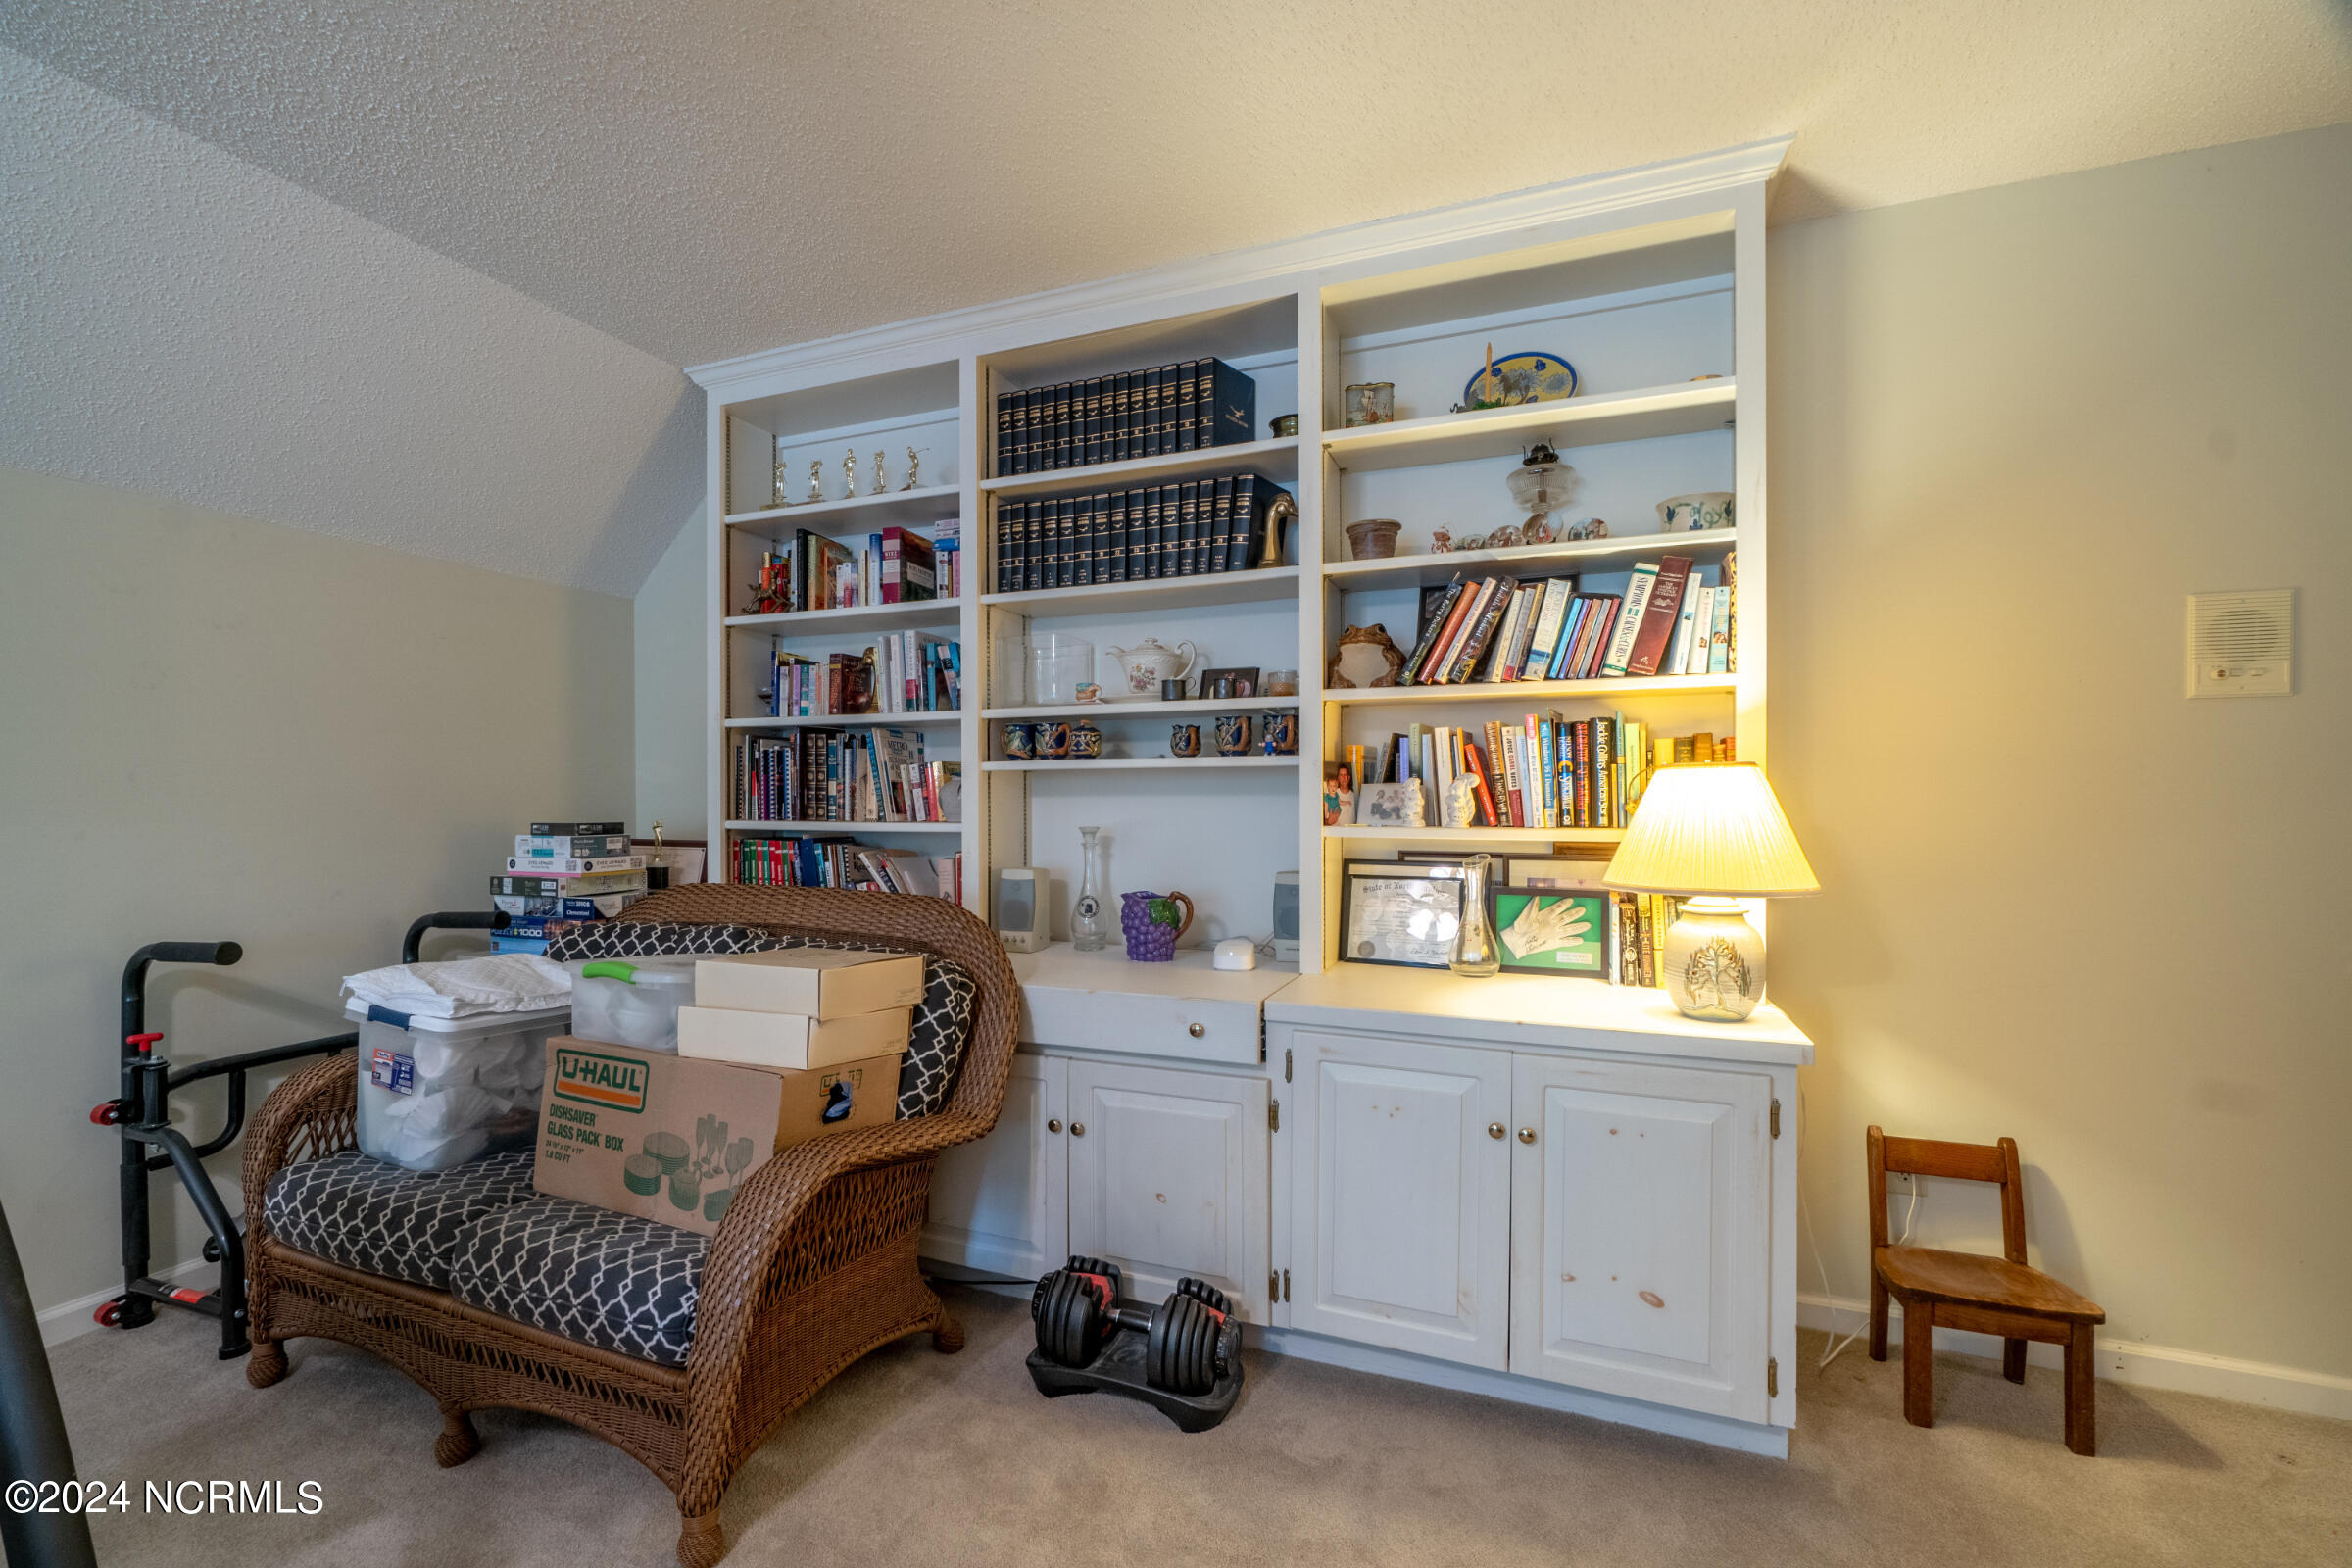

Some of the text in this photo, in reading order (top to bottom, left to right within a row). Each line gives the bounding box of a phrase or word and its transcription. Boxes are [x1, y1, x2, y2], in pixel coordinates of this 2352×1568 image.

[1631, 577, 1648, 607] SYMPTOMS
[1425, 588, 1456, 637] The Berry Pickers
[1596, 718, 1608, 770] Jackie Collins
[1599, 770, 1609, 815] American Star
[1363, 882, 1382, 894] State
[549, 1103, 597, 1127] DISHSAVER
[547, 1121, 624, 1152] GLASS PACK BOX
[555, 1152, 563, 1160] CU
[563, 1153, 571, 1164] FT
